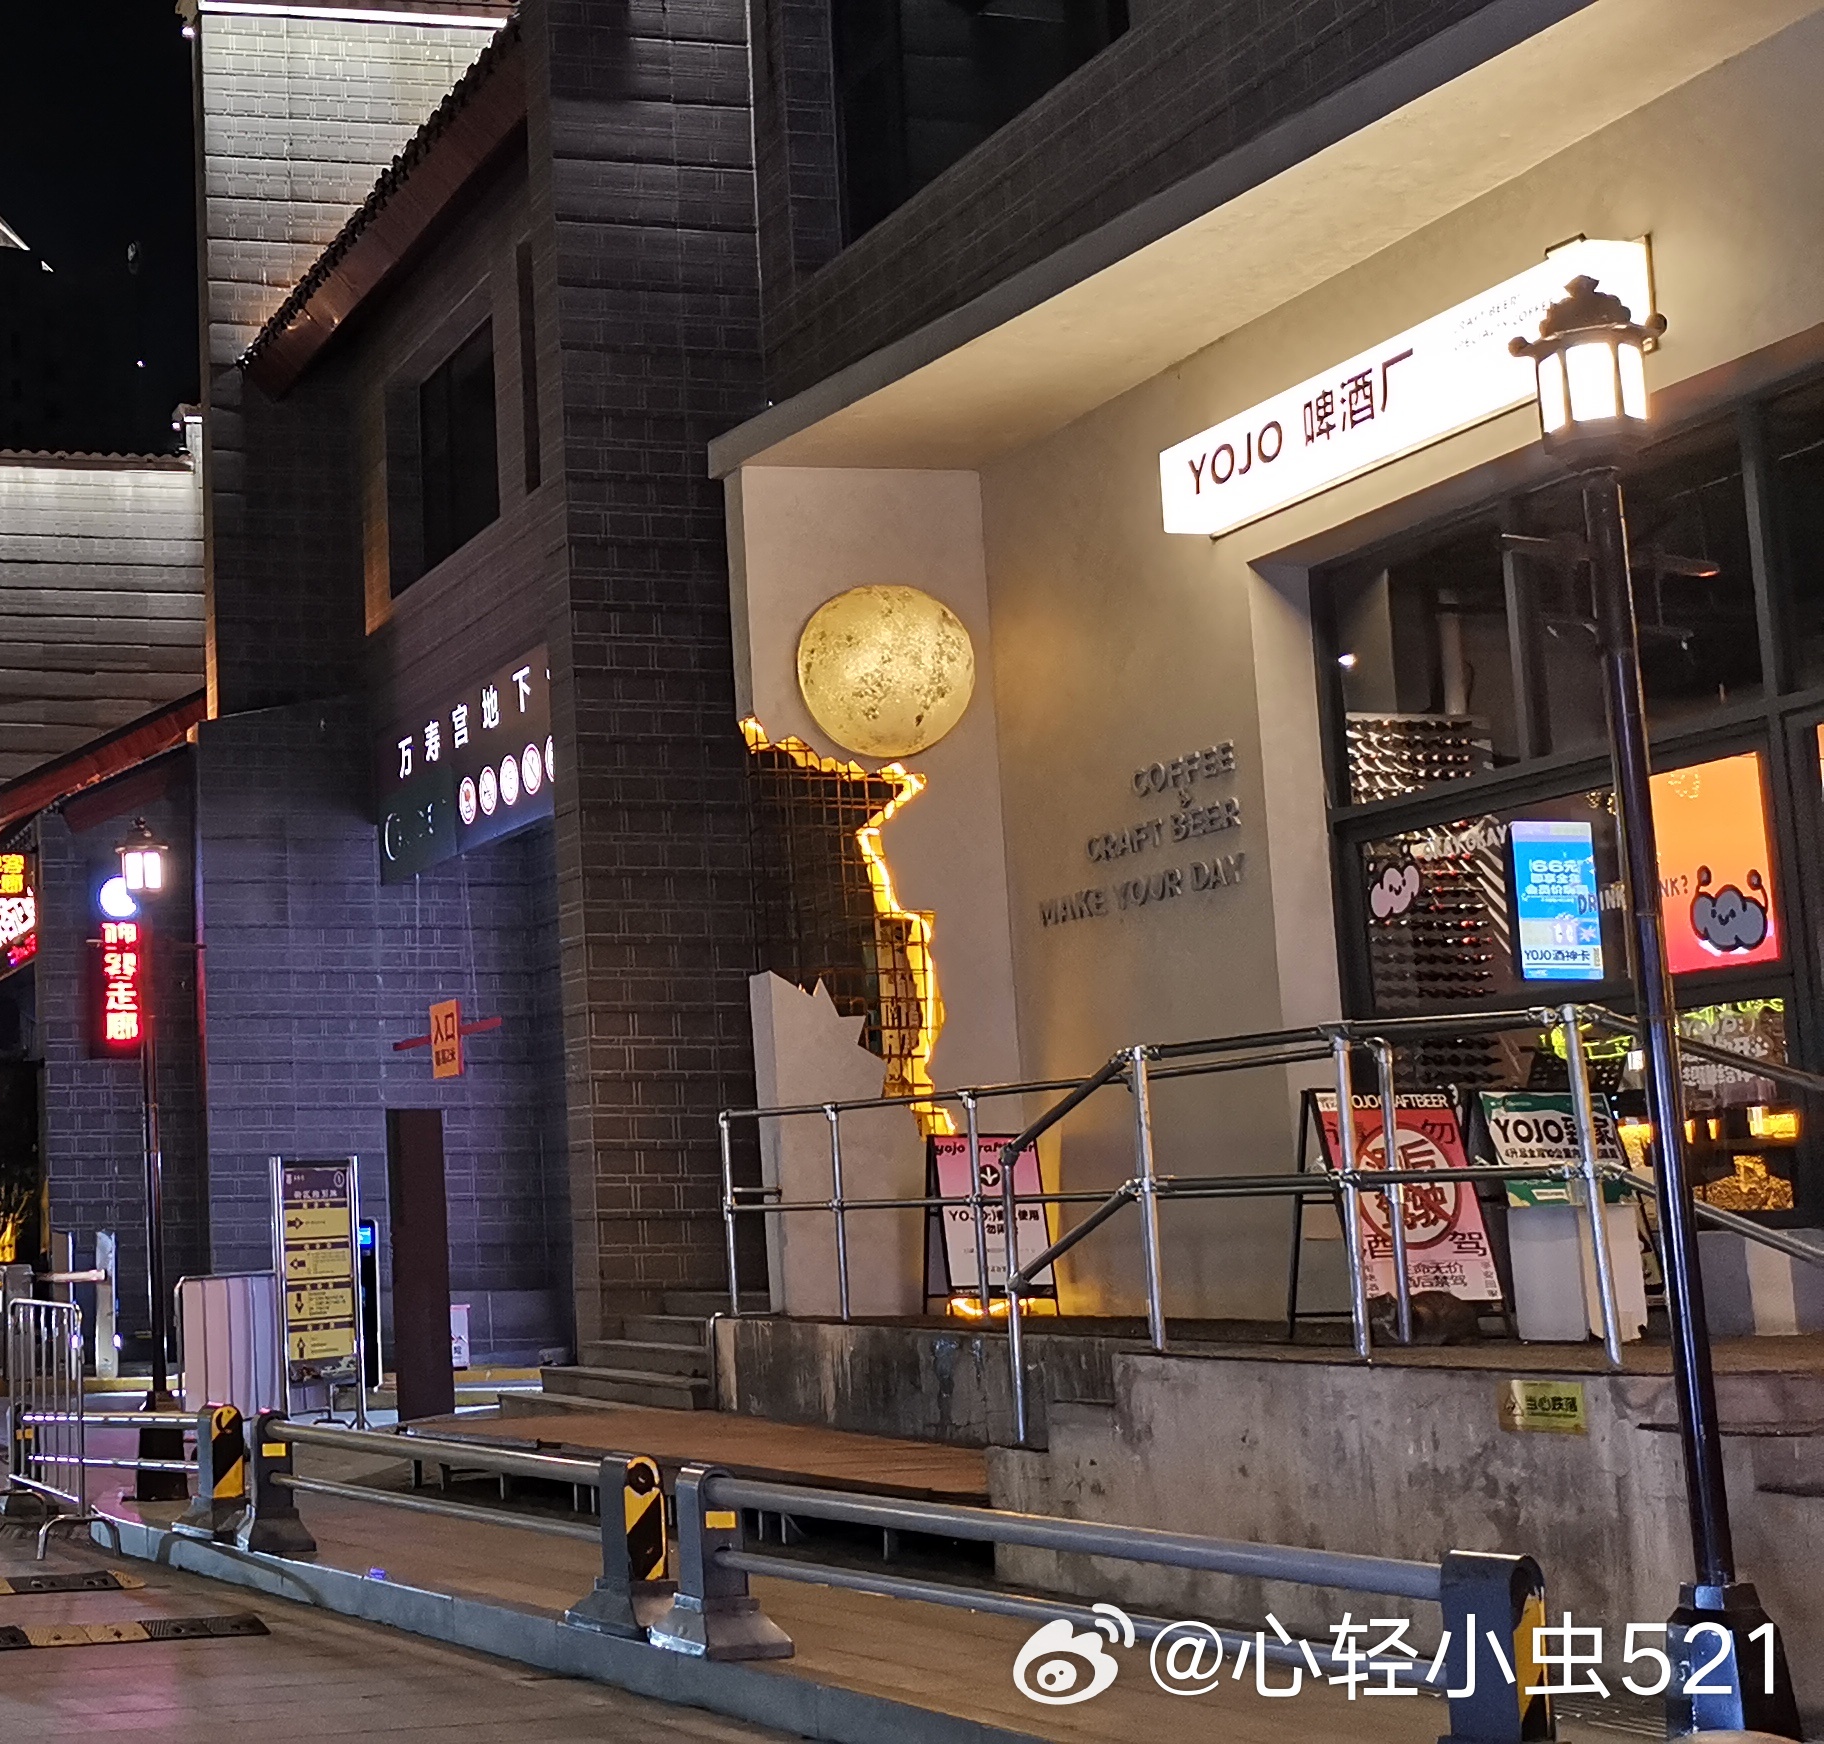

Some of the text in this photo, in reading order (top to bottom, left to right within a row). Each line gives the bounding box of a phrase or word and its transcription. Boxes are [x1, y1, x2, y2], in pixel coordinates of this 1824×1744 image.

[1188, 347, 1414, 496] YOJO 啤酒厂
[398, 666, 551, 779] 万寿宫地下
[1132, 738, 1236, 798] COFFEE
[1085, 797, 1242, 864] CRAFT BEER
[1039, 853, 1246, 928] MAKE YOUR DAY
[434, 1012, 456, 1045] 入口
